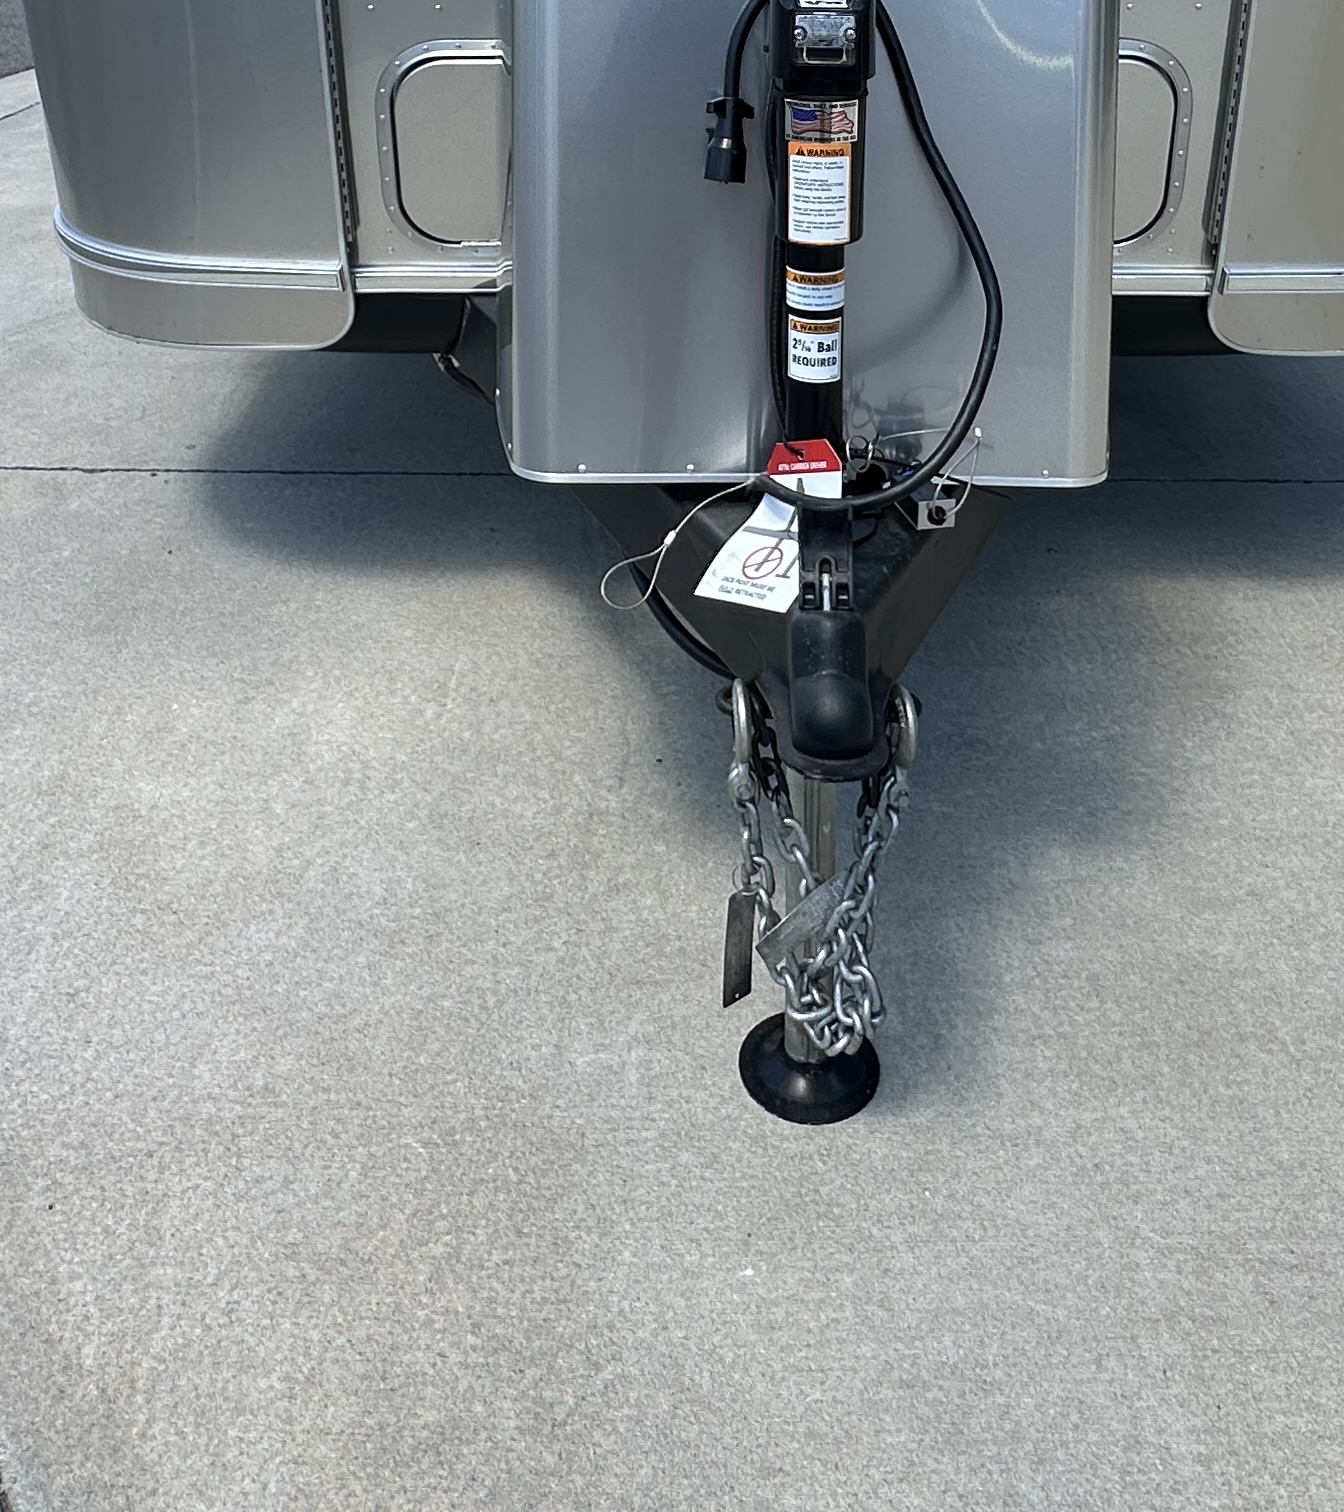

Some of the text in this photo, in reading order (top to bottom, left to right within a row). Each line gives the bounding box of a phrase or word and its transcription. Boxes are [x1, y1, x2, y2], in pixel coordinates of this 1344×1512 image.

[806, 148, 845, 157] WARNING
[799, 275, 839, 285] WARNING
[800, 323, 839, 333] WARNING
[817, 338, 838, 353] Ball
[792, 353, 838, 368] REQUIRED
